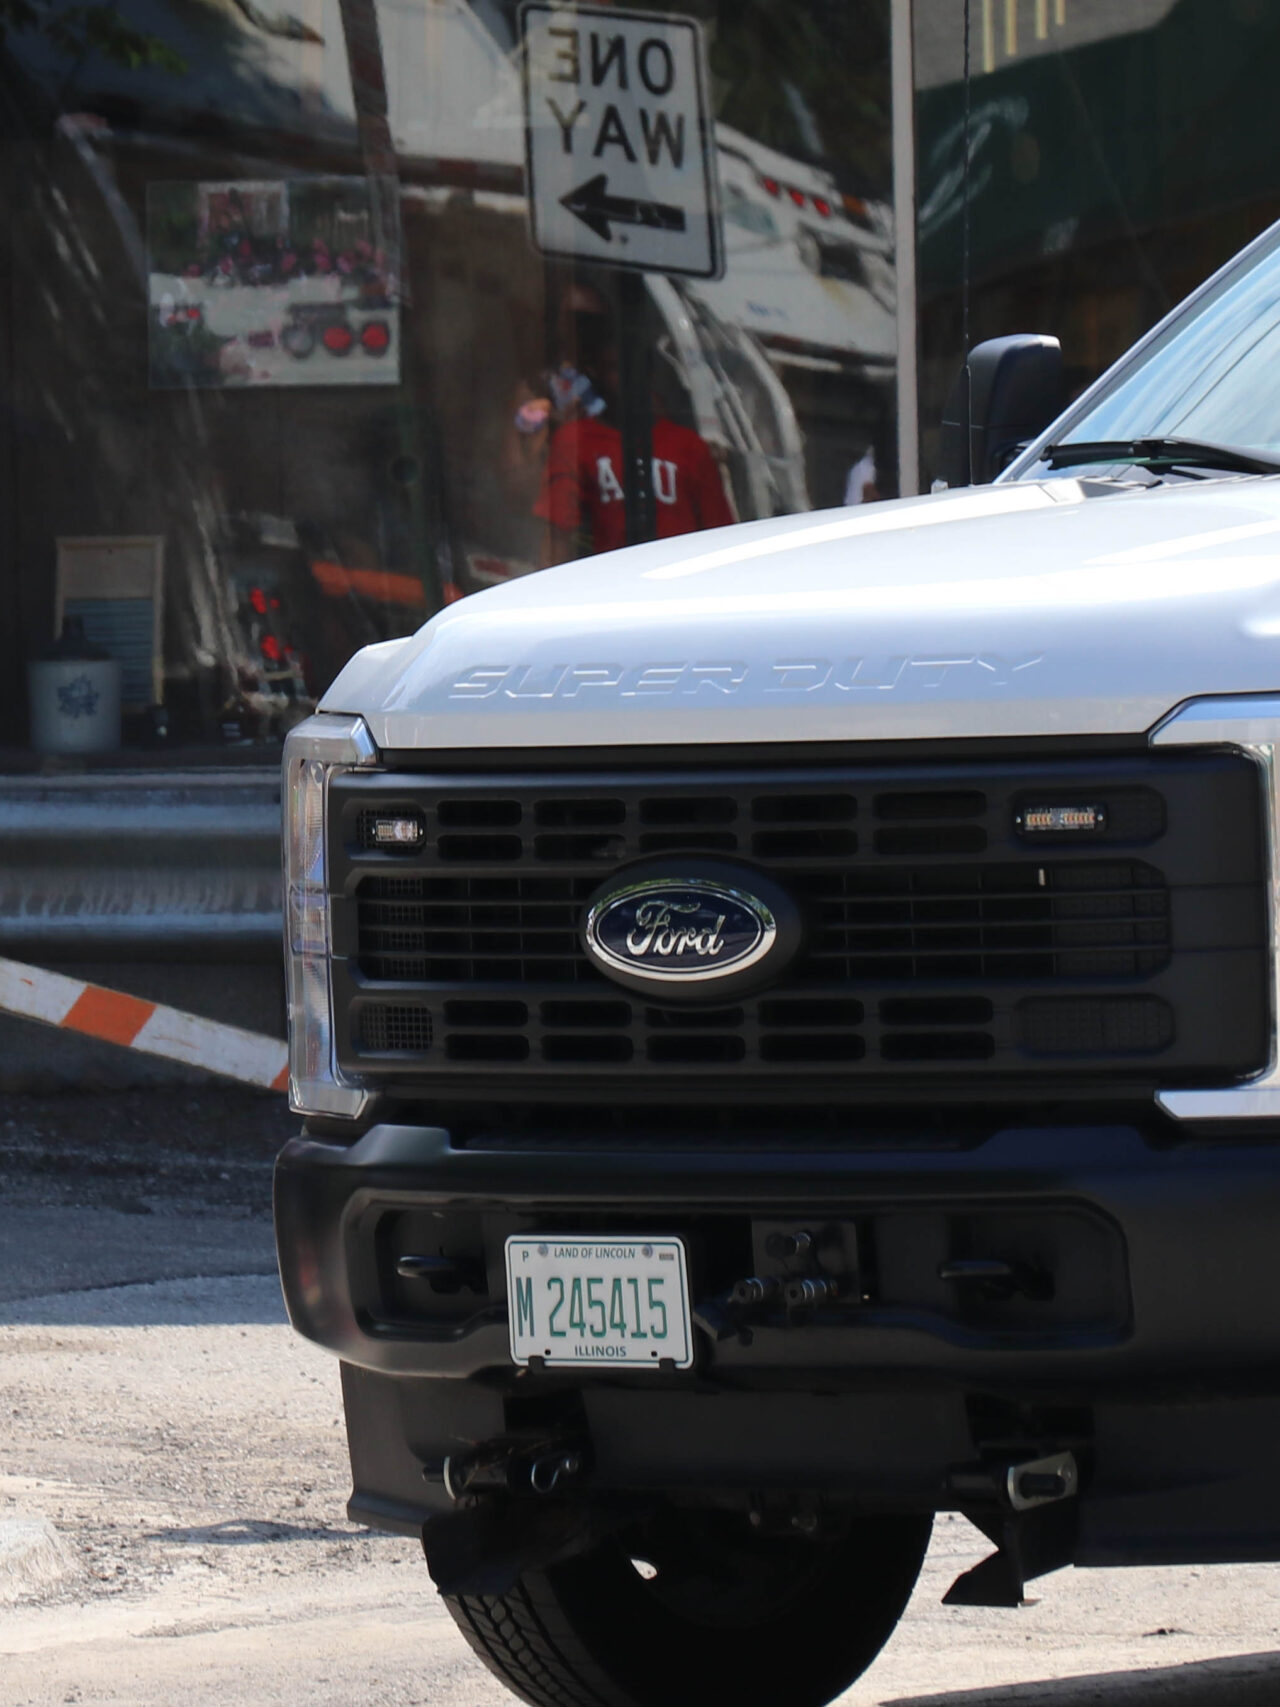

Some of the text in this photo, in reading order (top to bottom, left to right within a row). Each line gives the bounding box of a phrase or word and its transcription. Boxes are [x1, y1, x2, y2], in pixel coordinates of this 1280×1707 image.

[448, 653, 1044, 699] SUPER DUTY
[627, 900, 726, 956] Ford
[554, 1247, 636, 1259] LAND OF LINCOLN
[547, 1276, 668, 1339] 245415
[574, 1345, 627, 1357] ILLINOIS
